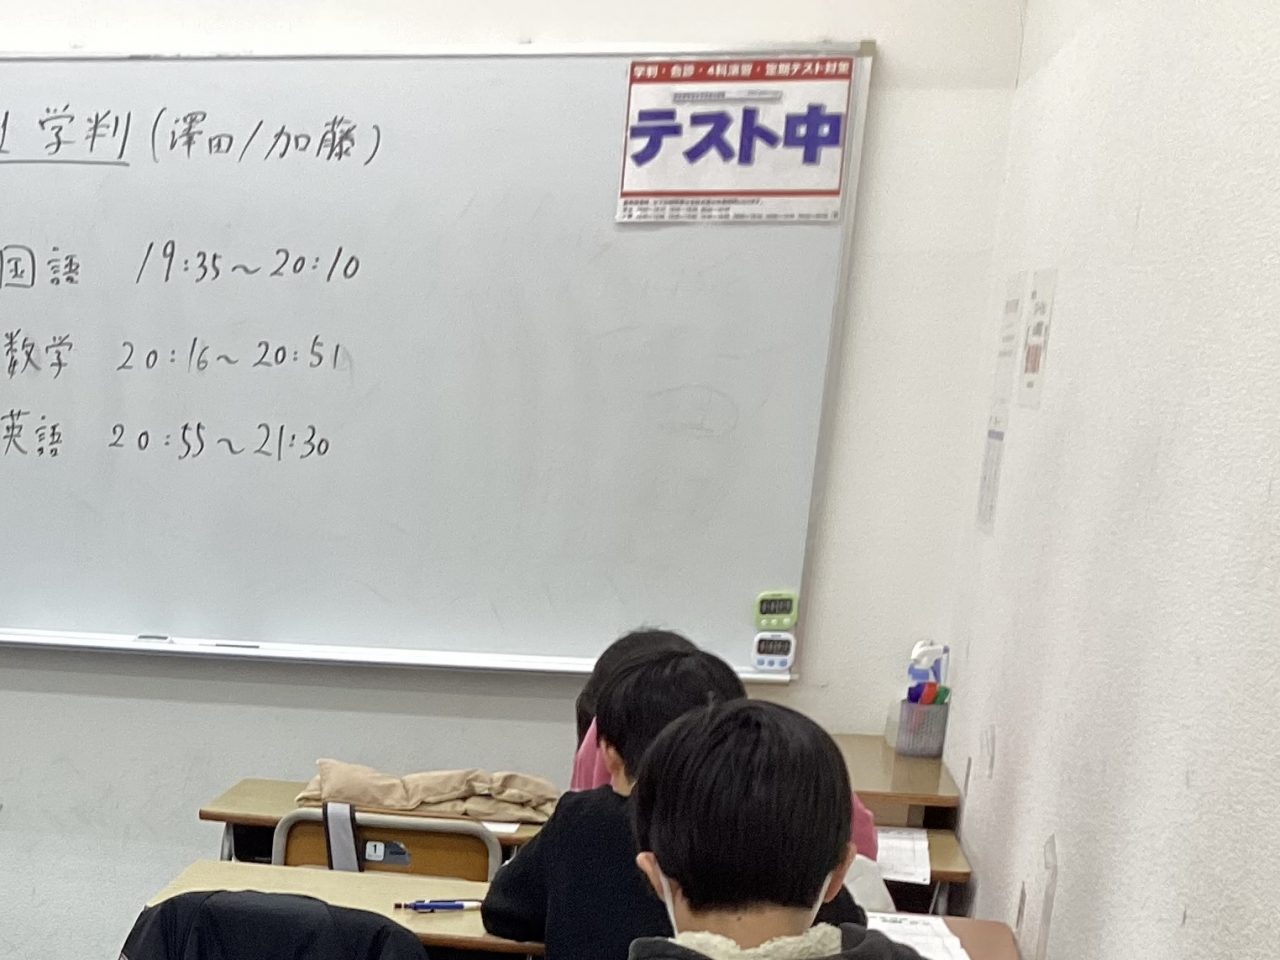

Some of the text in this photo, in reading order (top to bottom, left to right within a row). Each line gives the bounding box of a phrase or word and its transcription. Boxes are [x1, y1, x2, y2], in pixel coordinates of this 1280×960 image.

[630, 103, 843, 167] テスト中
[0, 245, 80, 288] 国語
[3, 329, 74, 378] 数学
[0, 409, 63, 457] 英語
